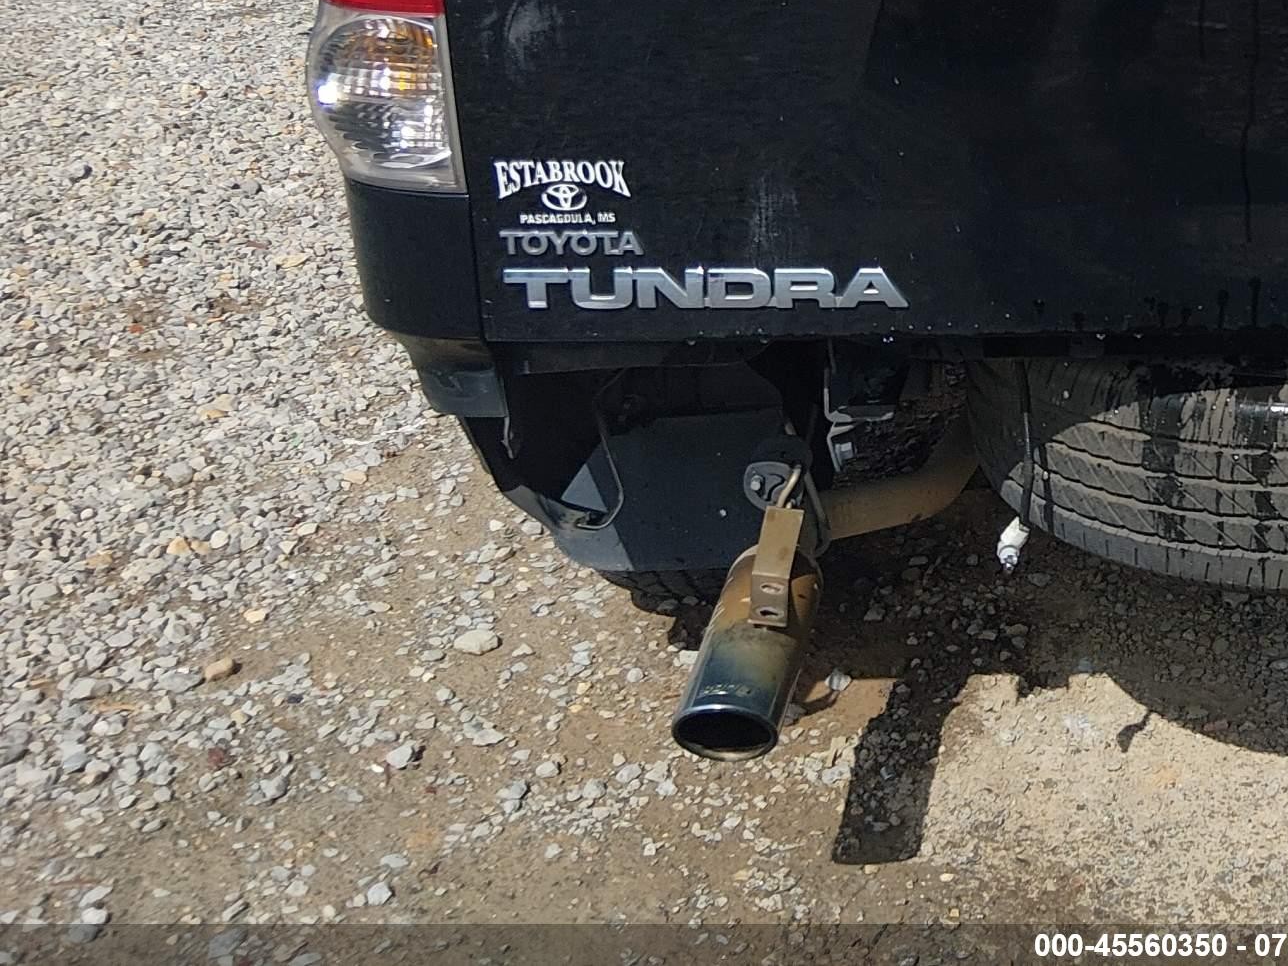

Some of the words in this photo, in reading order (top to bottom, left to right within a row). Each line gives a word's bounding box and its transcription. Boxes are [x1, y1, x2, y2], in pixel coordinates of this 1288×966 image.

[493, 159, 632, 199] ESTABROOK
[519, 212, 597, 225] PASCAGOULA,
[597, 211, 616, 224] MS
[499, 229, 644, 256] TOYOTA
[503, 265, 909, 309] TUNDRA
